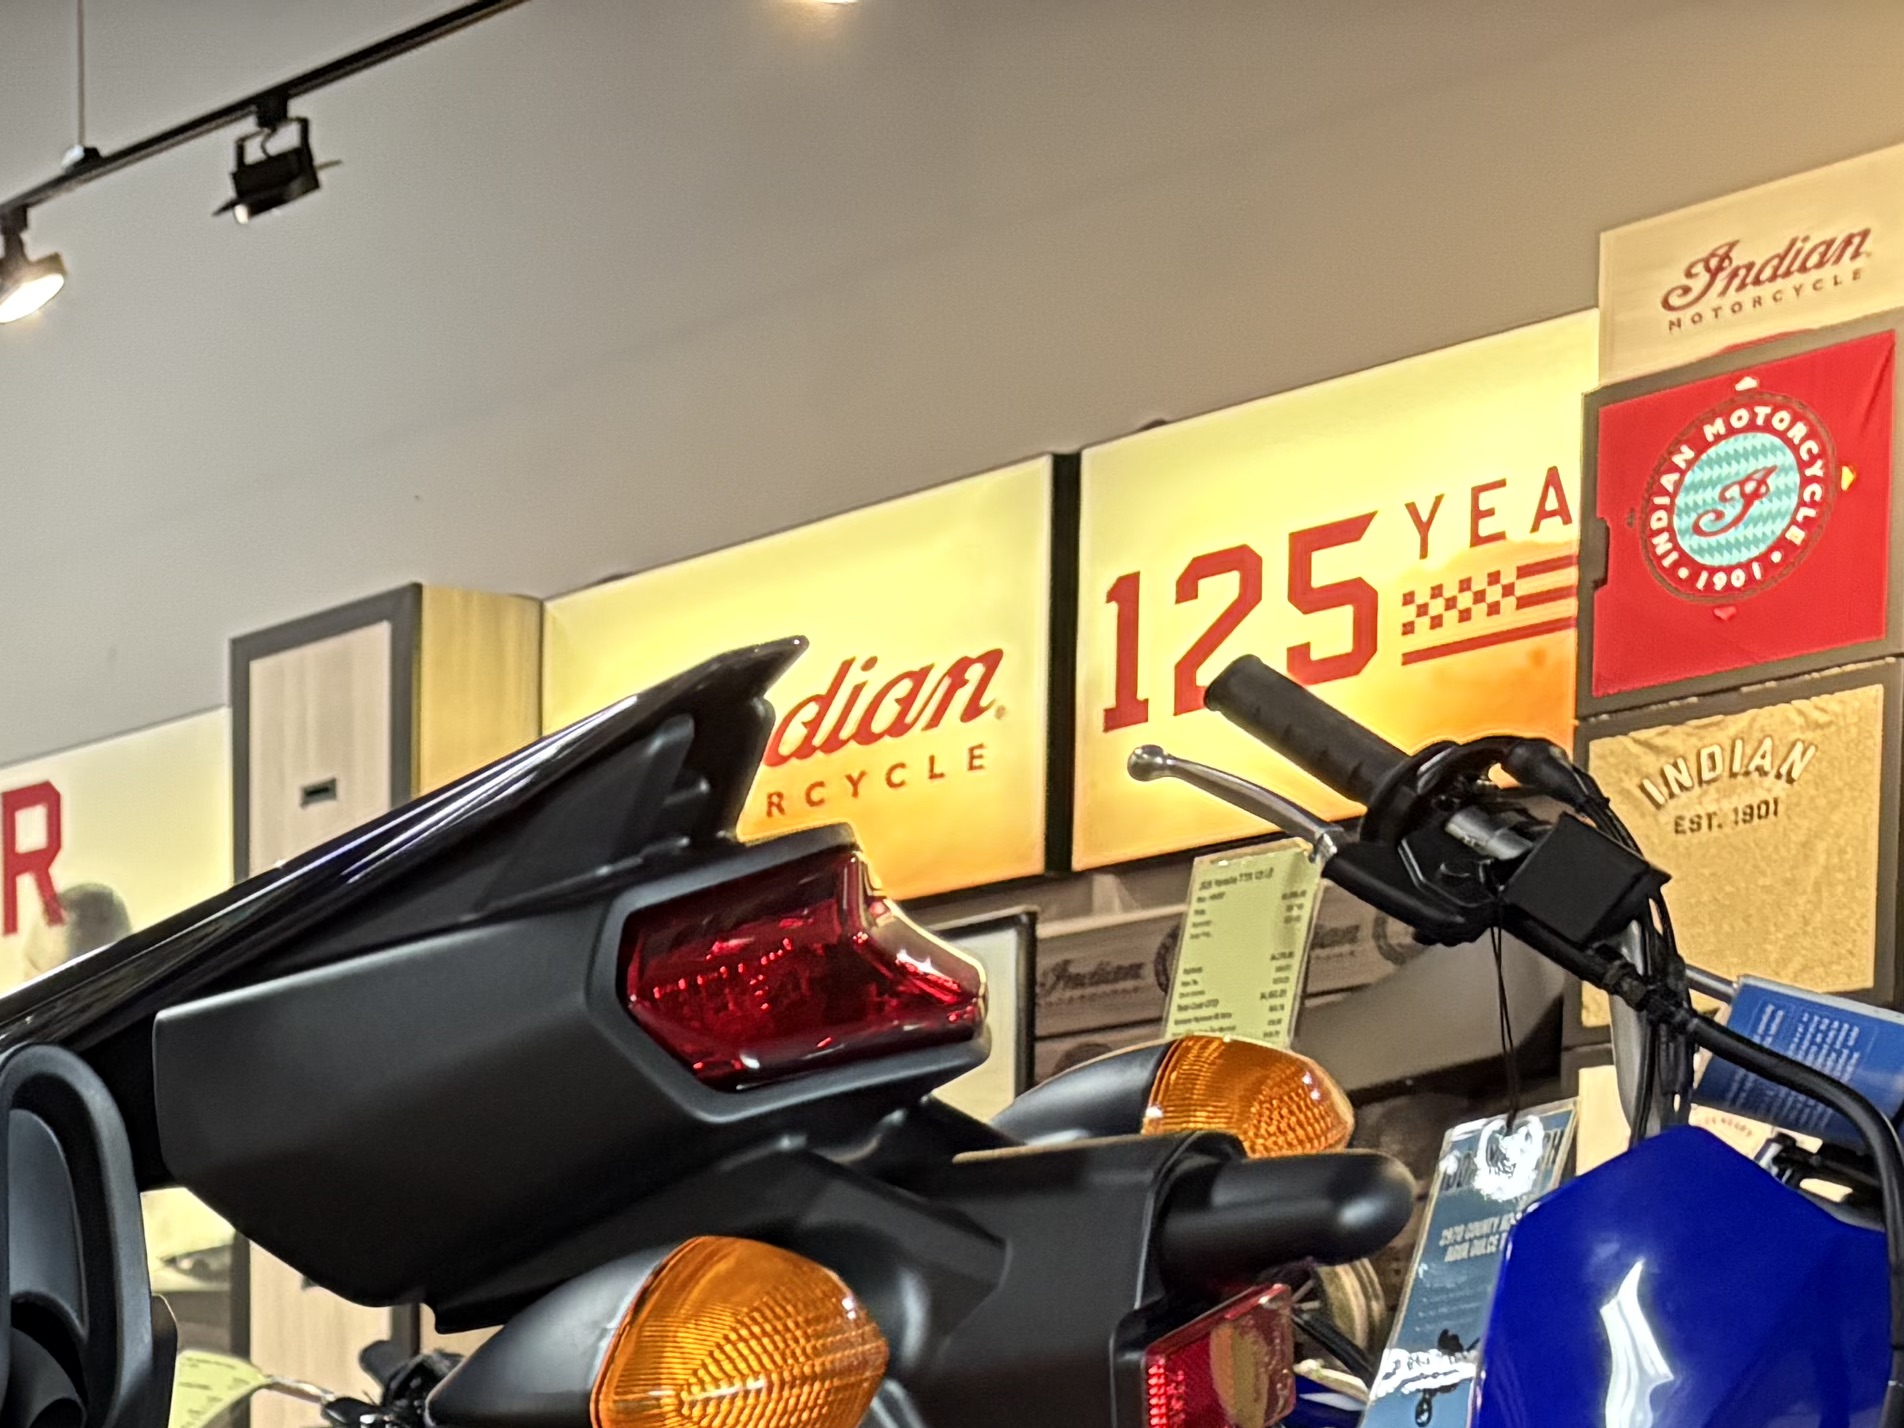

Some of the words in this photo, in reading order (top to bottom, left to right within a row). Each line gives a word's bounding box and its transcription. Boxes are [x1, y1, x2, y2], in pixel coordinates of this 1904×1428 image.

[1660, 227, 1872, 312] Indian
[1667, 267, 1863, 334] MOTORCYCLE
[1649, 443, 1696, 569] INDIAN
[1702, 404, 1825, 546] MOTORCYCLE
[1102, 510, 1380, 733] 125
[763, 647, 1004, 768] dian
[1638, 734, 1818, 810] INDIAN
[1673, 811, 1724, 836] EST.
[1732, 797, 1780, 827] 1901
